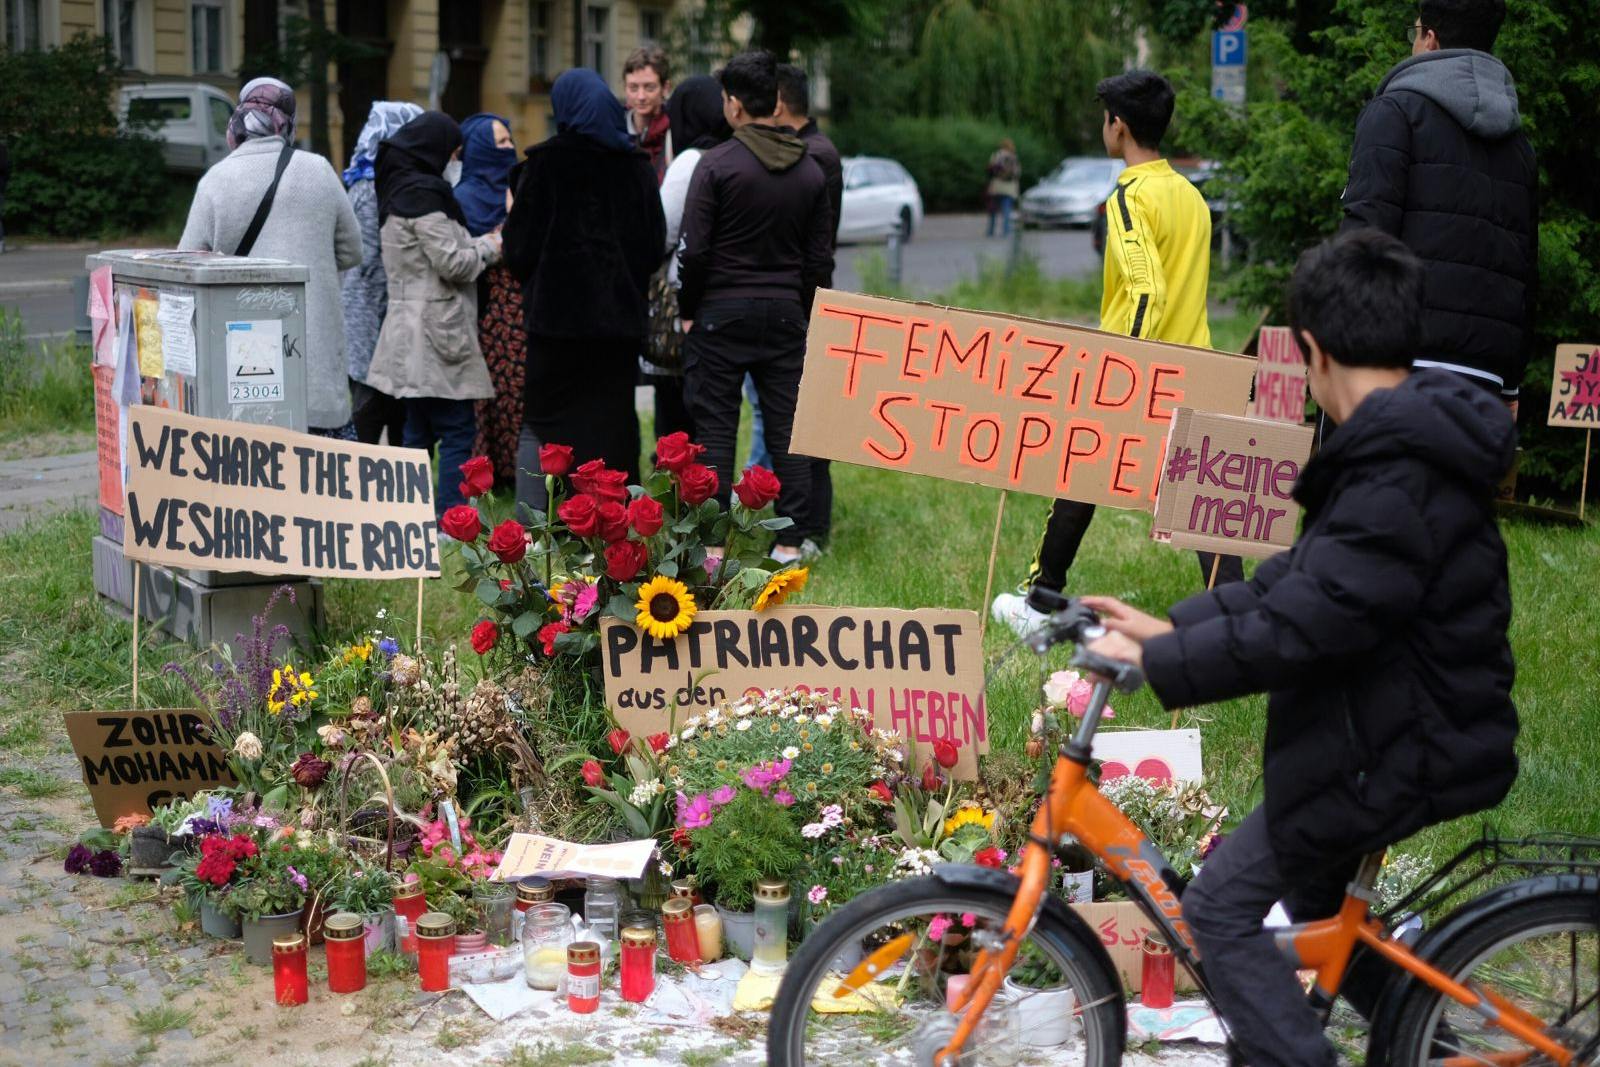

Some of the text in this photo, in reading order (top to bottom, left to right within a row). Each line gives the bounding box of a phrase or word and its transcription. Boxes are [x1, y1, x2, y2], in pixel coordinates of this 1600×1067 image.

[1219, 34, 1240, 63] P
[232, 384, 280, 400] 23004
[292, 446, 354, 500] THE
[358, 455, 430, 505] PAIN
[1166, 434, 1299, 501] #keine
[1187, 493, 1288, 541] mehr
[292, 516, 358, 571] THE
[360, 519, 441, 572] RAGE
[606, 614, 962, 678] PATRIARCHAT
[96, 712, 218, 749] ZOHR
[616, 684, 667, 710] aus
[675, 670, 726, 707] den
[888, 685, 987, 749] HEBEN
[534, 842, 556, 871] NEIN
